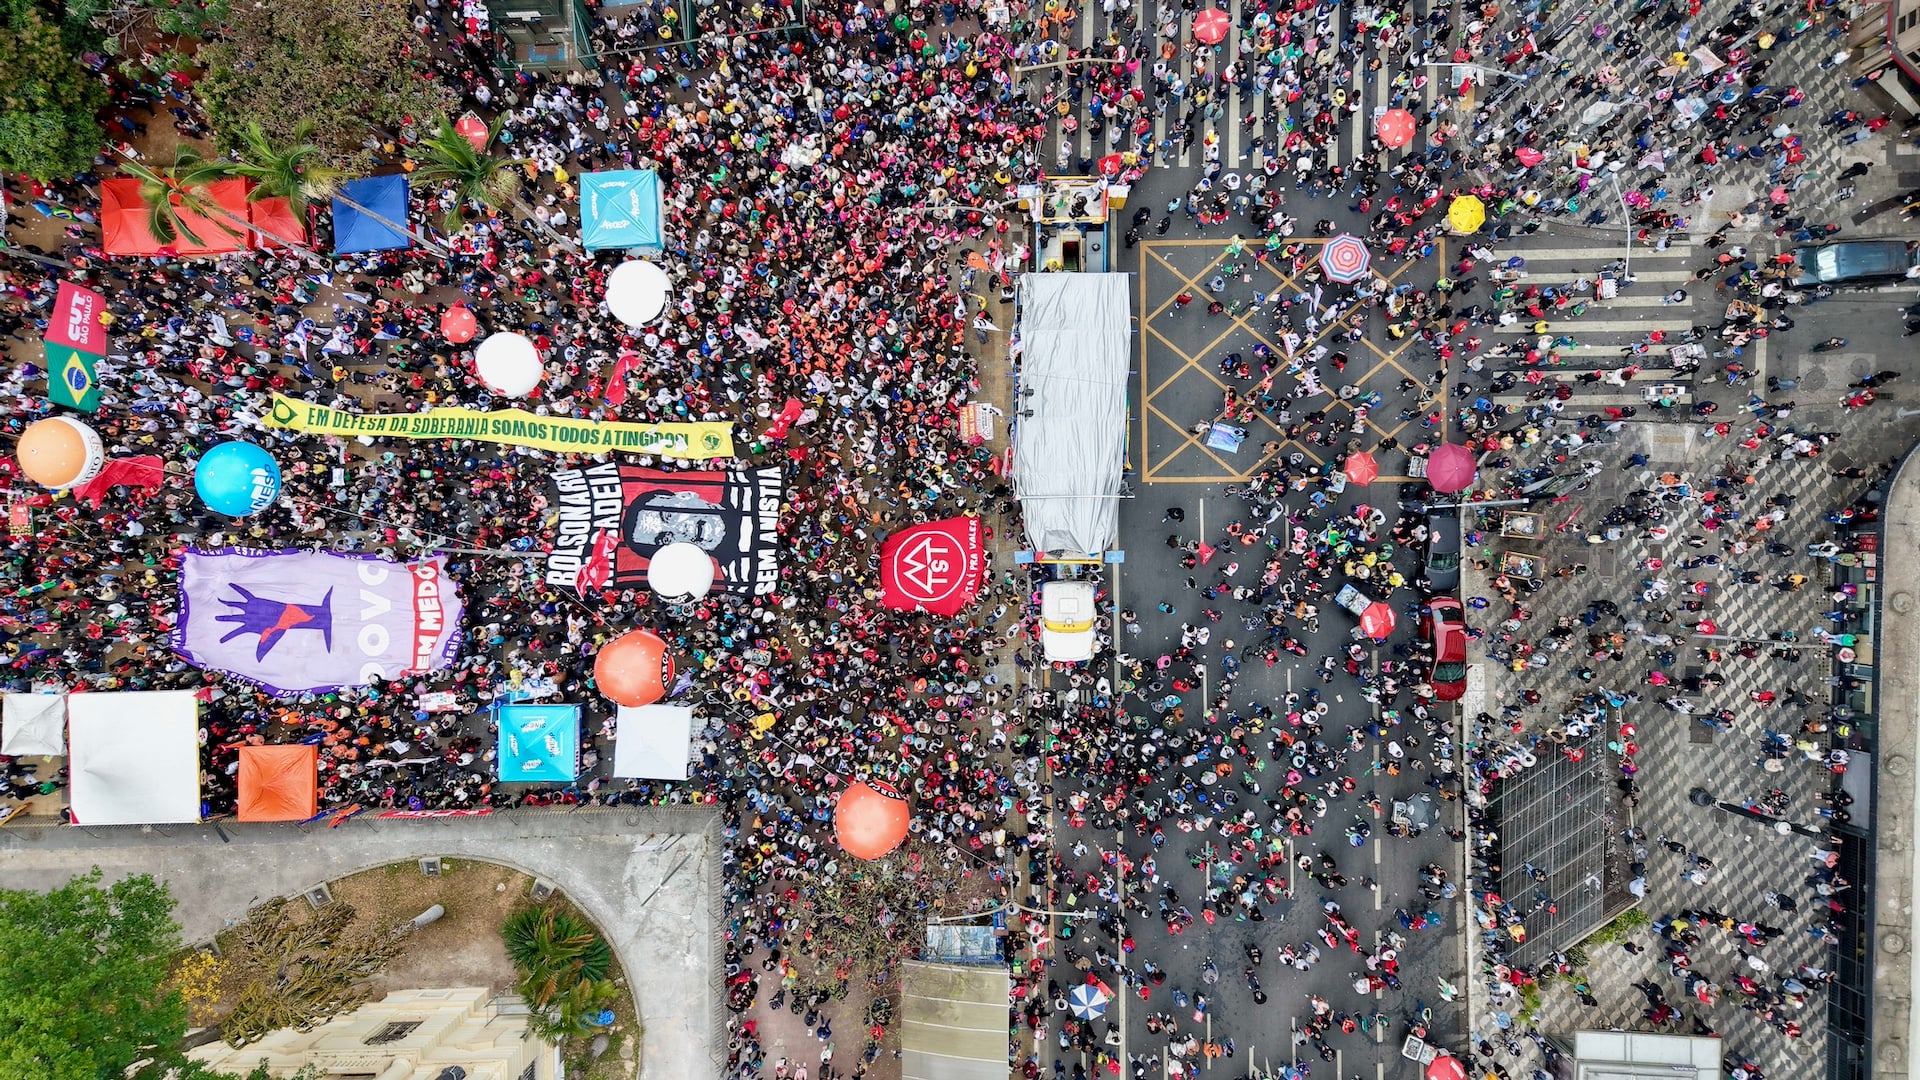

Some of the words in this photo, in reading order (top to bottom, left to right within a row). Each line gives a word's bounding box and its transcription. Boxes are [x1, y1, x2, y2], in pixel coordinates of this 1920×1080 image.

[68, 291, 86, 341] CUT
[83, 295, 93, 324] PAULO
[307, 407, 330, 426] EM
[332, 411, 386, 431] DEFESA
[388, 417, 409, 432] DA
[411, 417, 489, 435] SOBERANIA
[491, 419, 547, 439] SOMOS
[550, 425, 599, 445] TODOS
[546, 468, 591, 587] BOLSONARO
[755, 466, 783, 543] ANISTIA
[968, 519, 978, 550] VALER
[754, 548, 779, 596] SEM
[969, 553, 978, 571] PRA
[416, 566, 442, 631] MEDO
